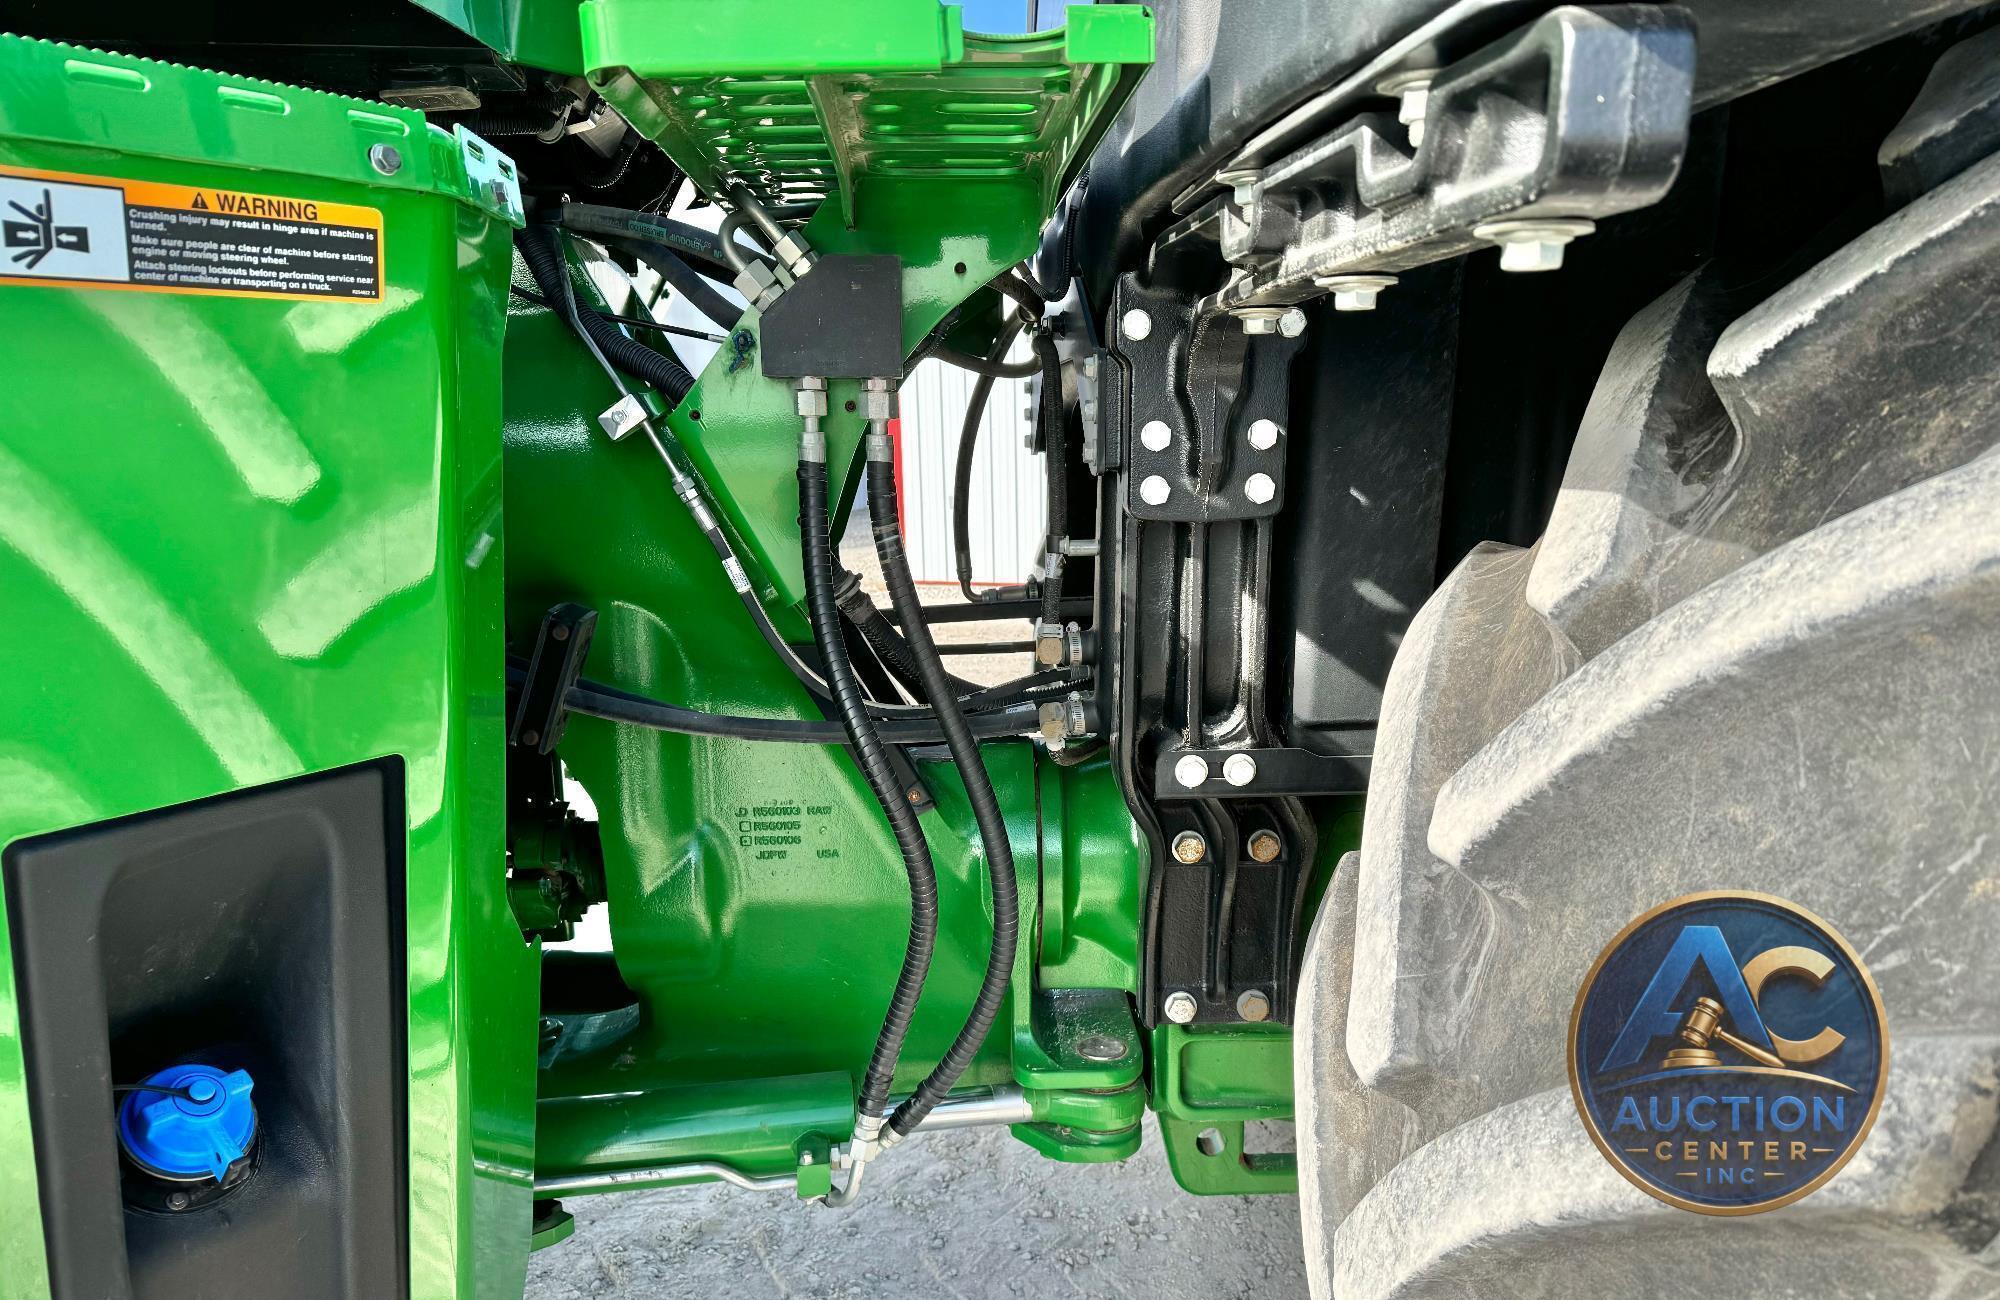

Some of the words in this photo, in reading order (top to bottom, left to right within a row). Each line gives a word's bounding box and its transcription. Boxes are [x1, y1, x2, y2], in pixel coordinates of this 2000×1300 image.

[216, 193, 318, 221] WARNING
[128, 208, 177, 223] Crushing
[179, 213, 208, 226] injury
[210, 218, 230, 228] may
[232, 219, 260, 230] result
[262, 221, 271, 230] in
[273, 222, 298, 234] hinge
[300, 226, 319, 235] area
[321, 228, 328, 236] if
[330, 229, 364, 240] machine
[366, 231, 374, 240] is
[130, 220, 167, 231] turned.
[131, 234, 159, 245] Make
[161, 239, 183, 247] sure
[185, 240, 218, 250] people
[220, 243, 236, 251] are
[238, 243, 260, 253] clear
[263, 246, 272, 254] of
[275, 247, 311, 257] machine
[313, 250, 340, 260] before
[342, 253, 374, 264] starting
[132, 247, 167, 257] engine
[183, 250, 218, 261] moving
[220, 253, 258, 265] steering
[261, 256, 289, 265] wheel.
[134, 260, 166, 270] Attach
[168, 262, 207, 275] steering
[209, 265, 247, 276] lockouts
[249, 268, 277, 277] before
[279, 271, 324, 282] performing
[326, 274, 355, 283] service
[357, 276, 374, 284] near
[134, 271, 165, 280] center
[168, 272, 178, 281] of
[180, 274, 219, 284] machine
[221, 277, 231, 285] or
[233, 277, 287, 290] transporting
[289, 281, 300, 289] on
[309, 282, 332, 291] truck.
[753, 821, 801, 831] R560105
[816, 848, 840, 859] USA
